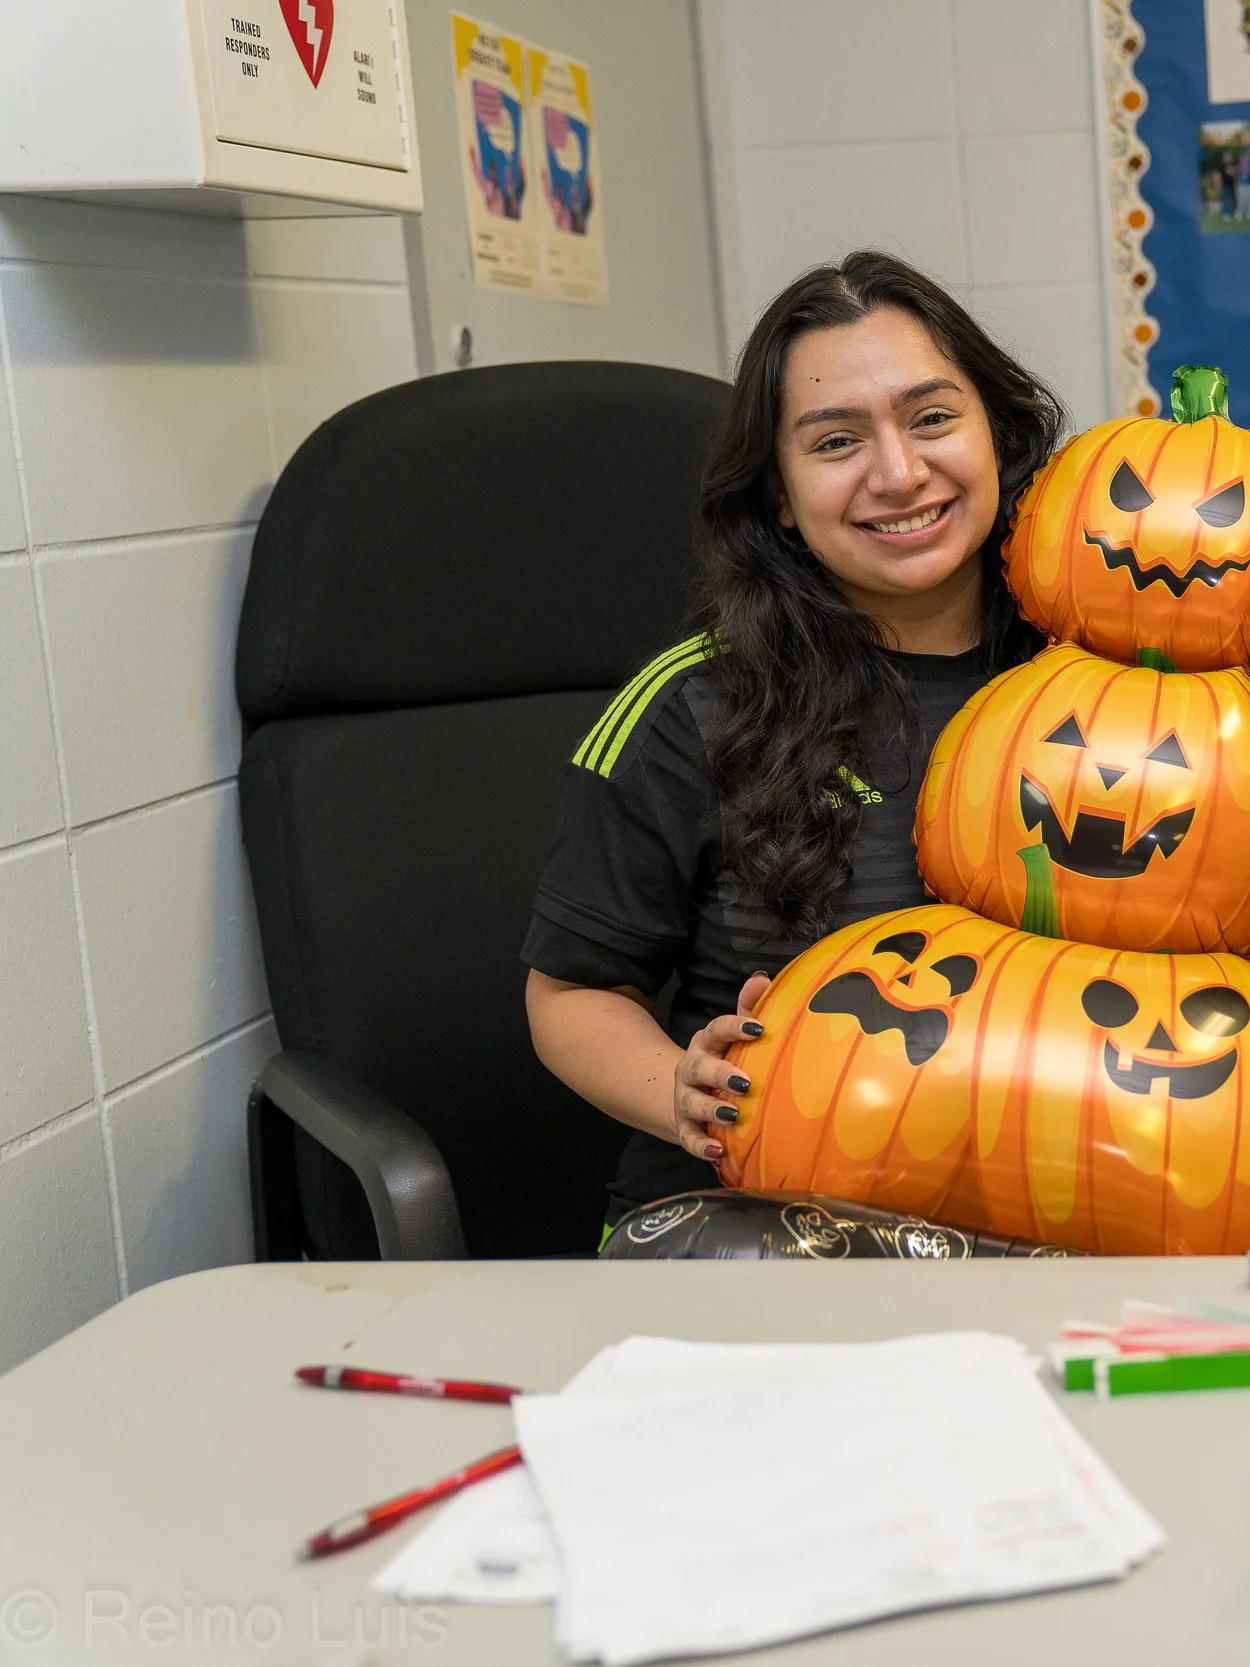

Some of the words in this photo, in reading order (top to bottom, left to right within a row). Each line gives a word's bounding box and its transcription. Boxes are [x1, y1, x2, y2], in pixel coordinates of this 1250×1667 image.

[231, 17, 261, 38] TRAINED
[225, 36, 270, 61] RESPONDERS
[241, 61, 259, 78] ONLY
[357, 70, 373, 86] WILL
[357, 88, 376, 105] SOUND
